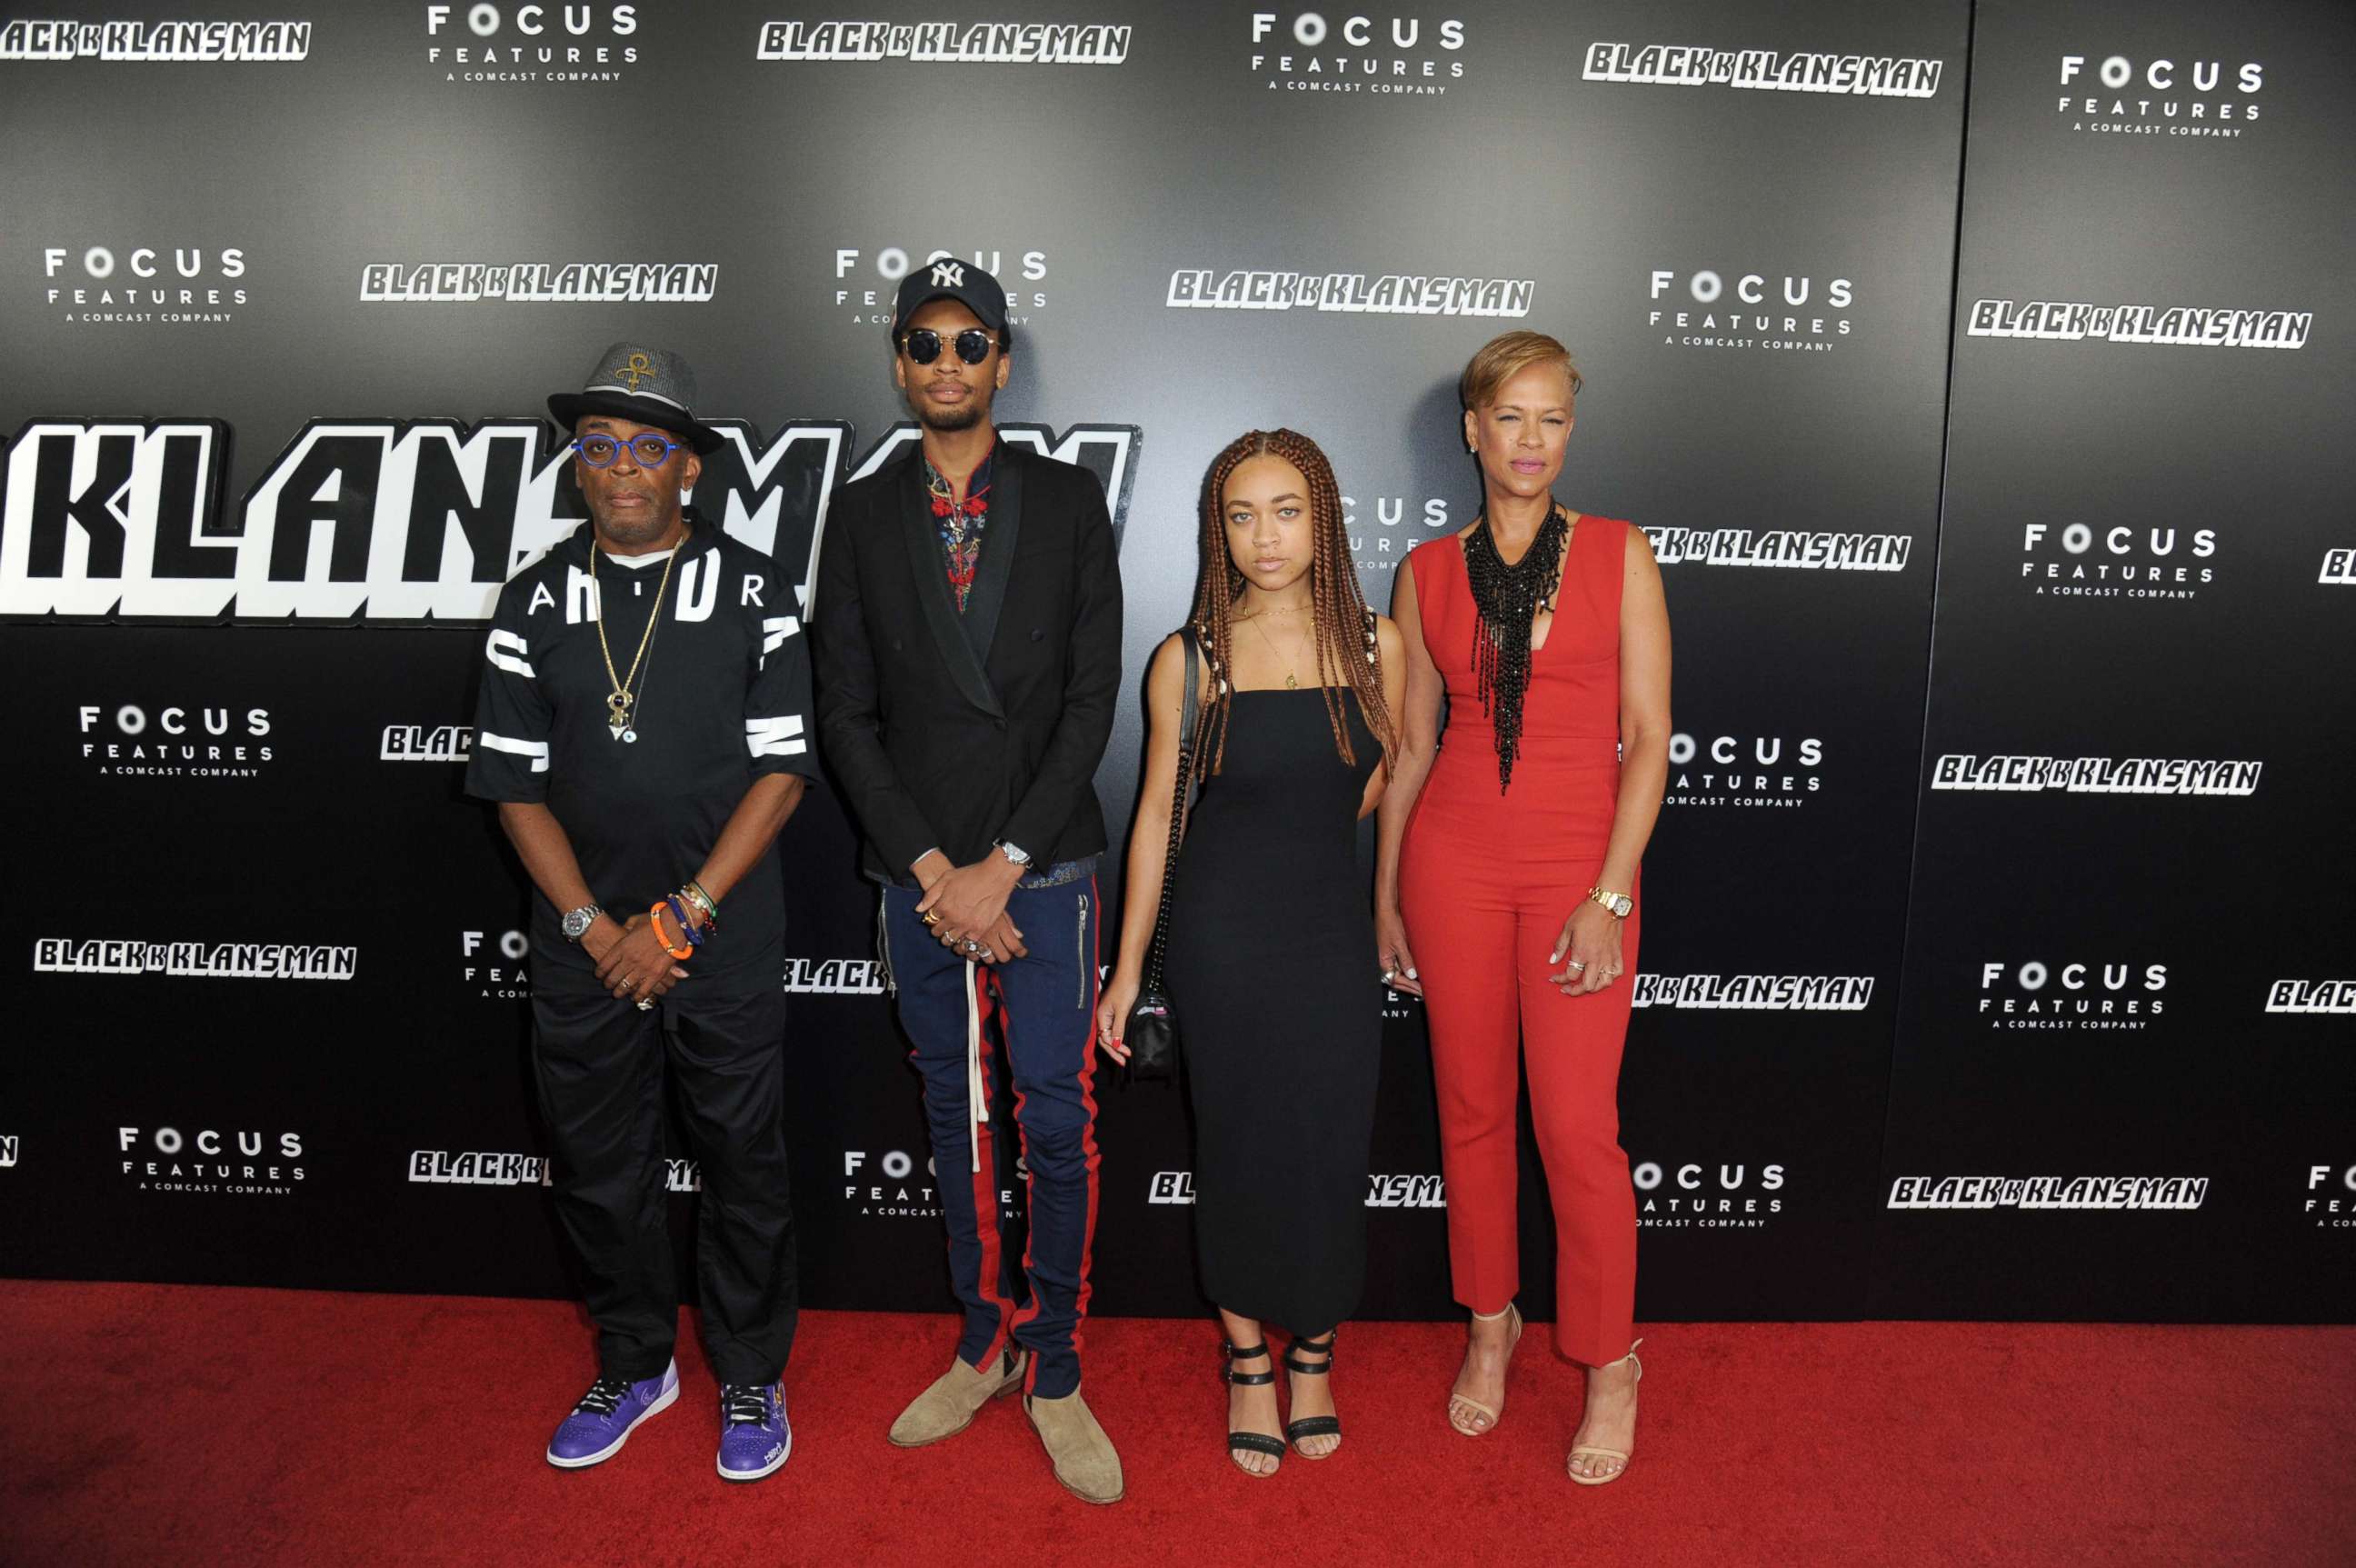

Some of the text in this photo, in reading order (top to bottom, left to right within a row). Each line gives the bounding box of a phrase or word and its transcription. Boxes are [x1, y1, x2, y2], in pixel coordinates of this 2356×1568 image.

[427, 3, 637, 36] FOCUS
[1253, 13, 1464, 50] FOCUS
[428, 47, 637, 64] FEATURES
[1252, 55, 1463, 78] FEATURES
[2061, 55, 2262, 94] FOCUS
[446, 72, 620, 82] A COMCAST COMPANY
[1268, 80, 1446, 95] A COMCAST COMPANY
[2058, 97, 2259, 120] FEATURES
[2073, 122, 2241, 137] A COMCAST COMPANY
[45, 246, 245, 278] FOCUS
[836, 247, 1047, 281] FOUS
[47, 289, 246, 305] FEATURES
[1650, 270, 1852, 309] FOCUS
[836, 290, 1046, 307] FEES
[65, 313, 231, 322] A COMCAST COMPANY
[853, 315, 862, 324] A
[1649, 312, 1851, 334] FEATURES
[1665, 335, 1833, 352] A COMCAST COMPANY
[1341, 496, 1448, 527] CUS
[2024, 523, 2216, 557] FOCUS
[1357, 560, 1397, 570] COMP
[2022, 562, 2212, 583] FEATURES
[2036, 586, 2195, 599] A COMCAST COMPANY
[79, 705, 271, 736] FOCUS
[83, 744, 273, 761] FEATURES
[1669, 734, 1822, 766] OCUS
[100, 766, 258, 777] A COMCAST COMPANY
[1676, 774, 1820, 792] ATURES
[1666, 796, 1802, 807] OMCAST COMPANY
[1982, 962, 2167, 991] FOCUS
[1979, 999, 2163, 1014] FEATURES
[1992, 1020, 2146, 1029] A COMCAST COMPANY
[119, 1127, 303, 1158] FOCUS
[123, 1161, 304, 1181] FEATURES
[1632, 1162, 1784, 1190] OCUS
[140, 1182, 291, 1194] A COMCAST COMPANY
[845, 1186, 1012, 1203] FEATE
[862, 1207, 869, 1215] A
[1643, 1199, 1782, 1213] ATURES
[1635, 1219, 1765, 1227] OMCAST COMPANY
